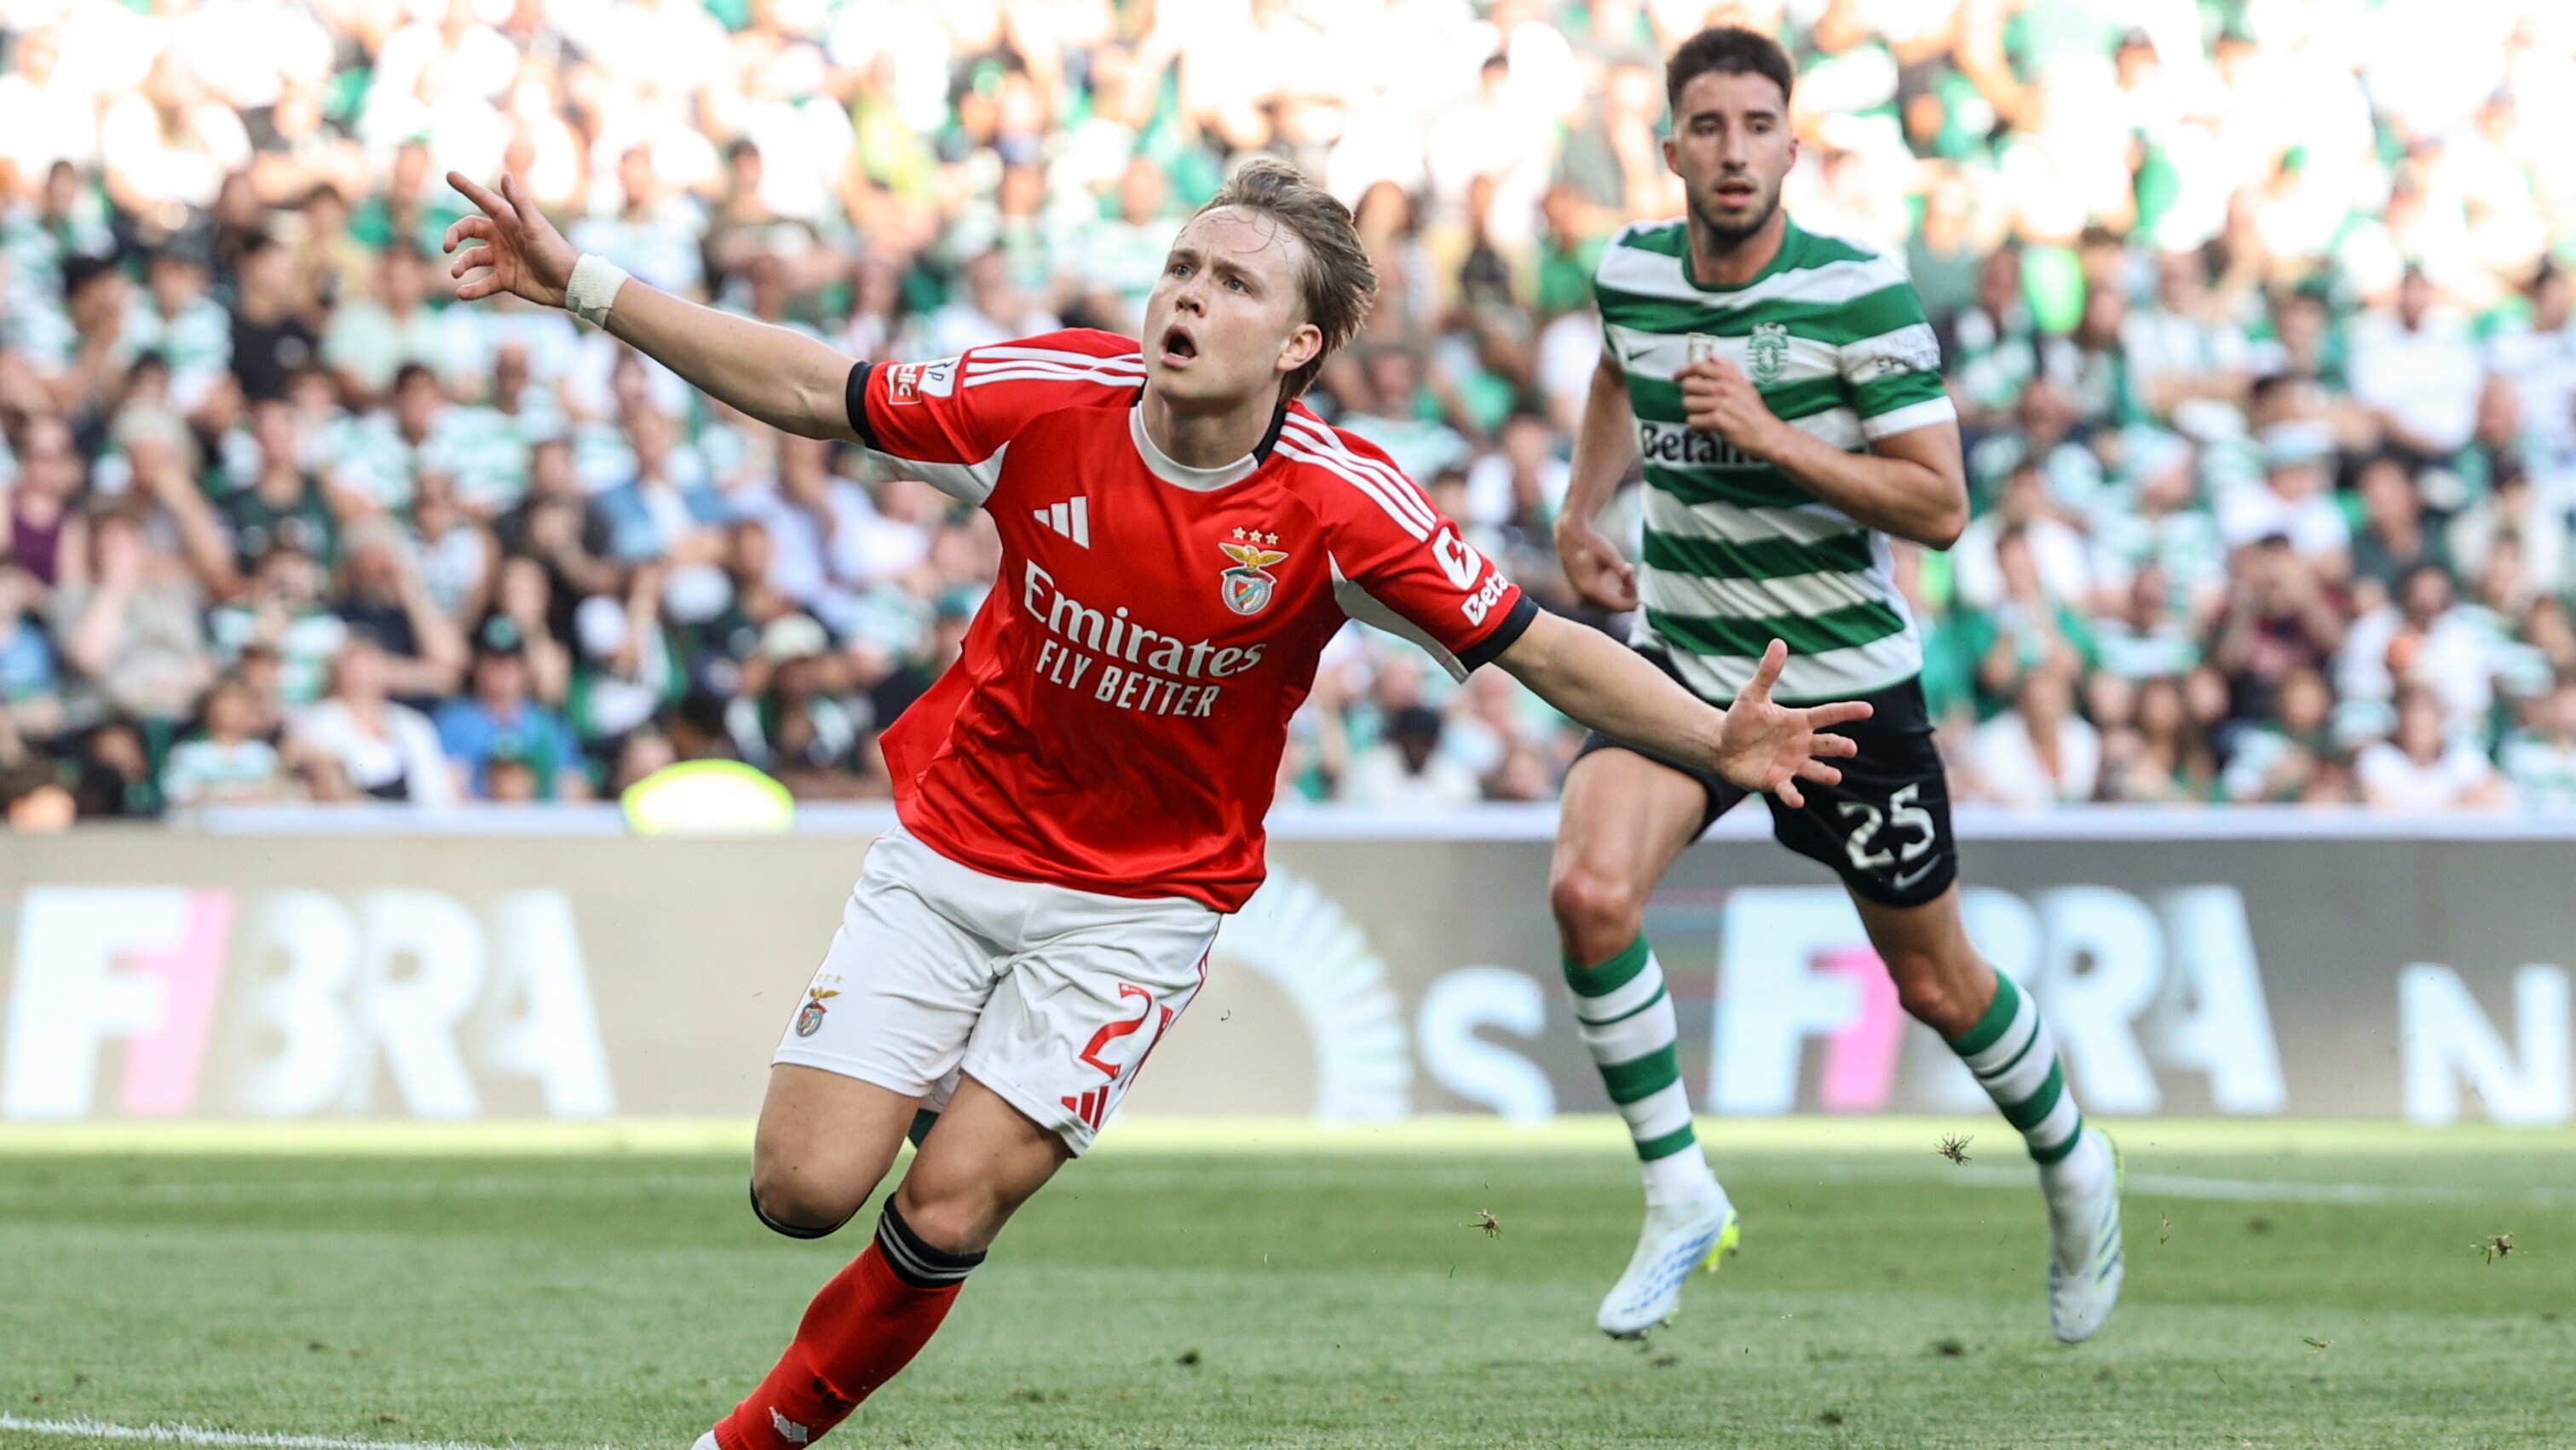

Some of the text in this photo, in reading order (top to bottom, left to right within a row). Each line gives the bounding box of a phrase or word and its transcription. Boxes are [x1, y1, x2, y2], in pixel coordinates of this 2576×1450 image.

[1642, 423, 1771, 464] Betan
[1023, 558, 1268, 679] Emirates
[1034, 638, 1221, 717] FLY BETTER
[1836, 781, 1936, 870] 25
[3, 884, 616, 1119] FIBRA
